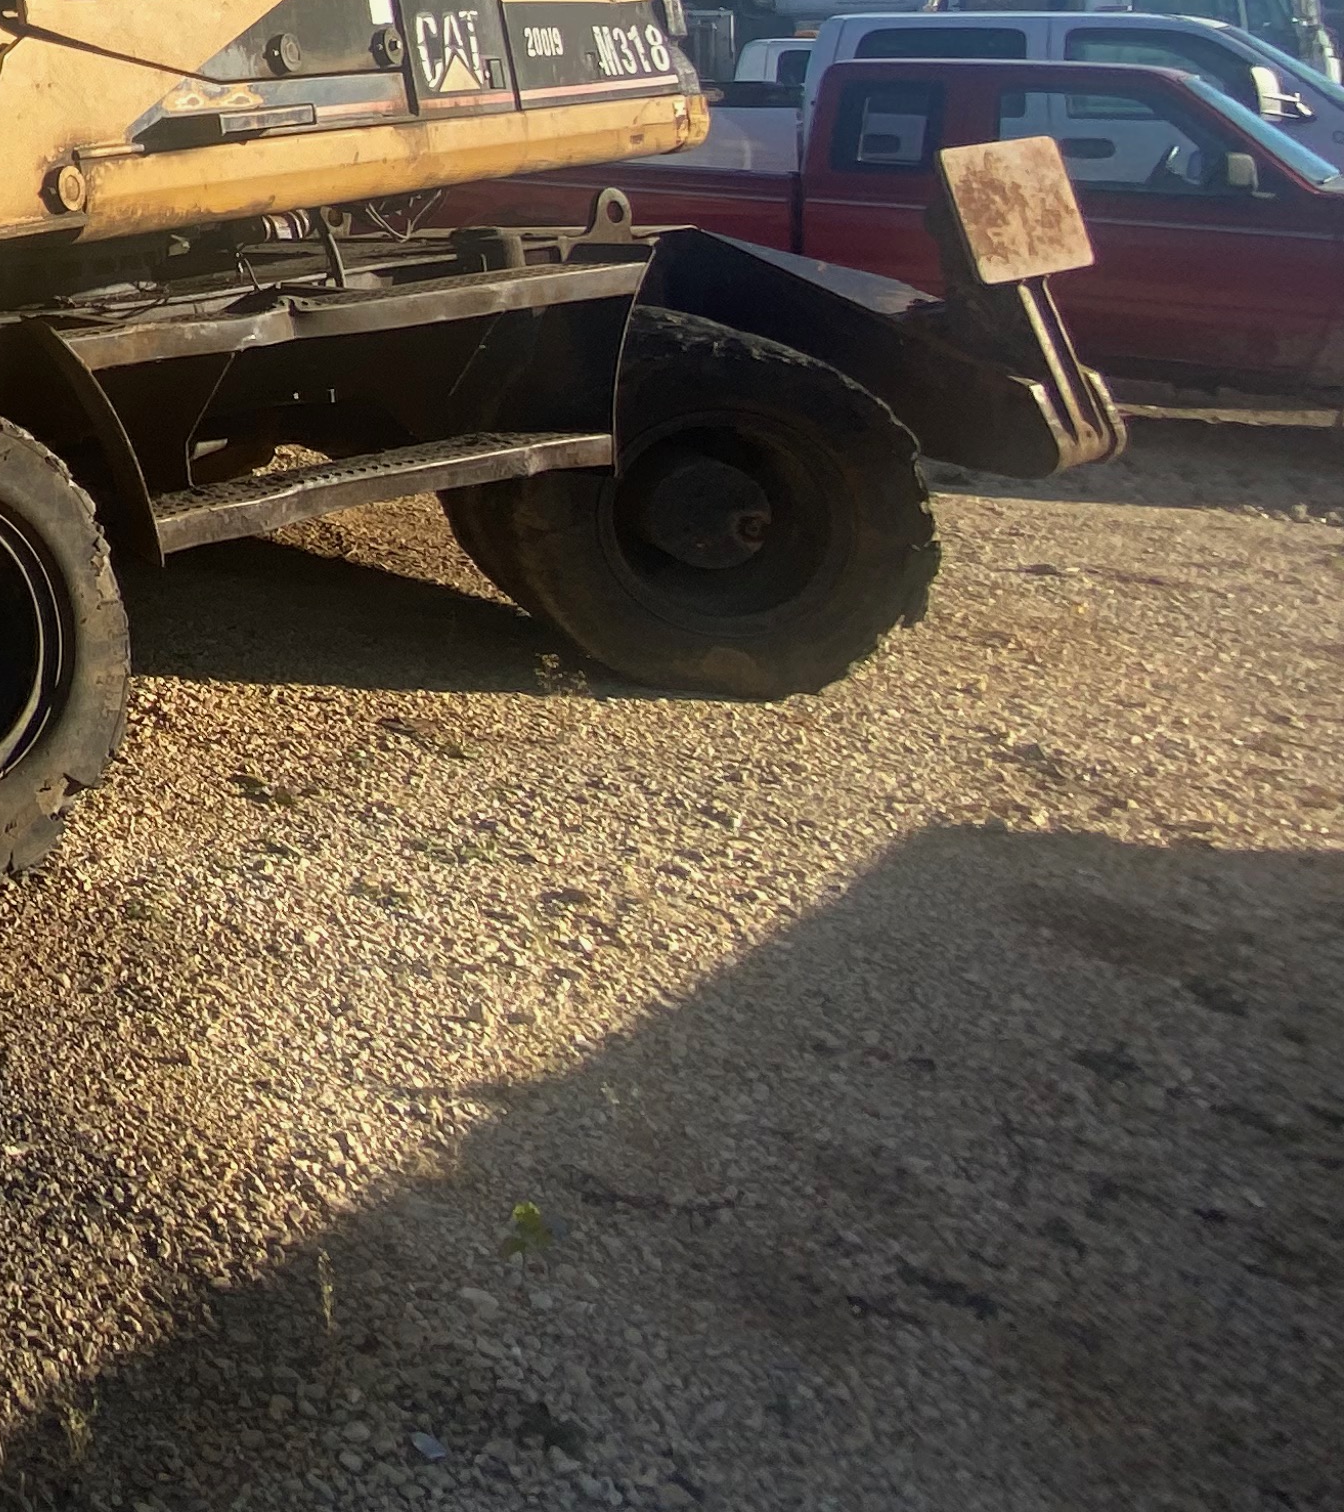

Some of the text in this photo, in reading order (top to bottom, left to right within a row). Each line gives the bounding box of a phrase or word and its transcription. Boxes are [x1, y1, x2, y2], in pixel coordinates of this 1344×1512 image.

[416, 10, 485, 90] CAT
[524, 26, 564, 58] 20019
[592, 23, 671, 77] M318
